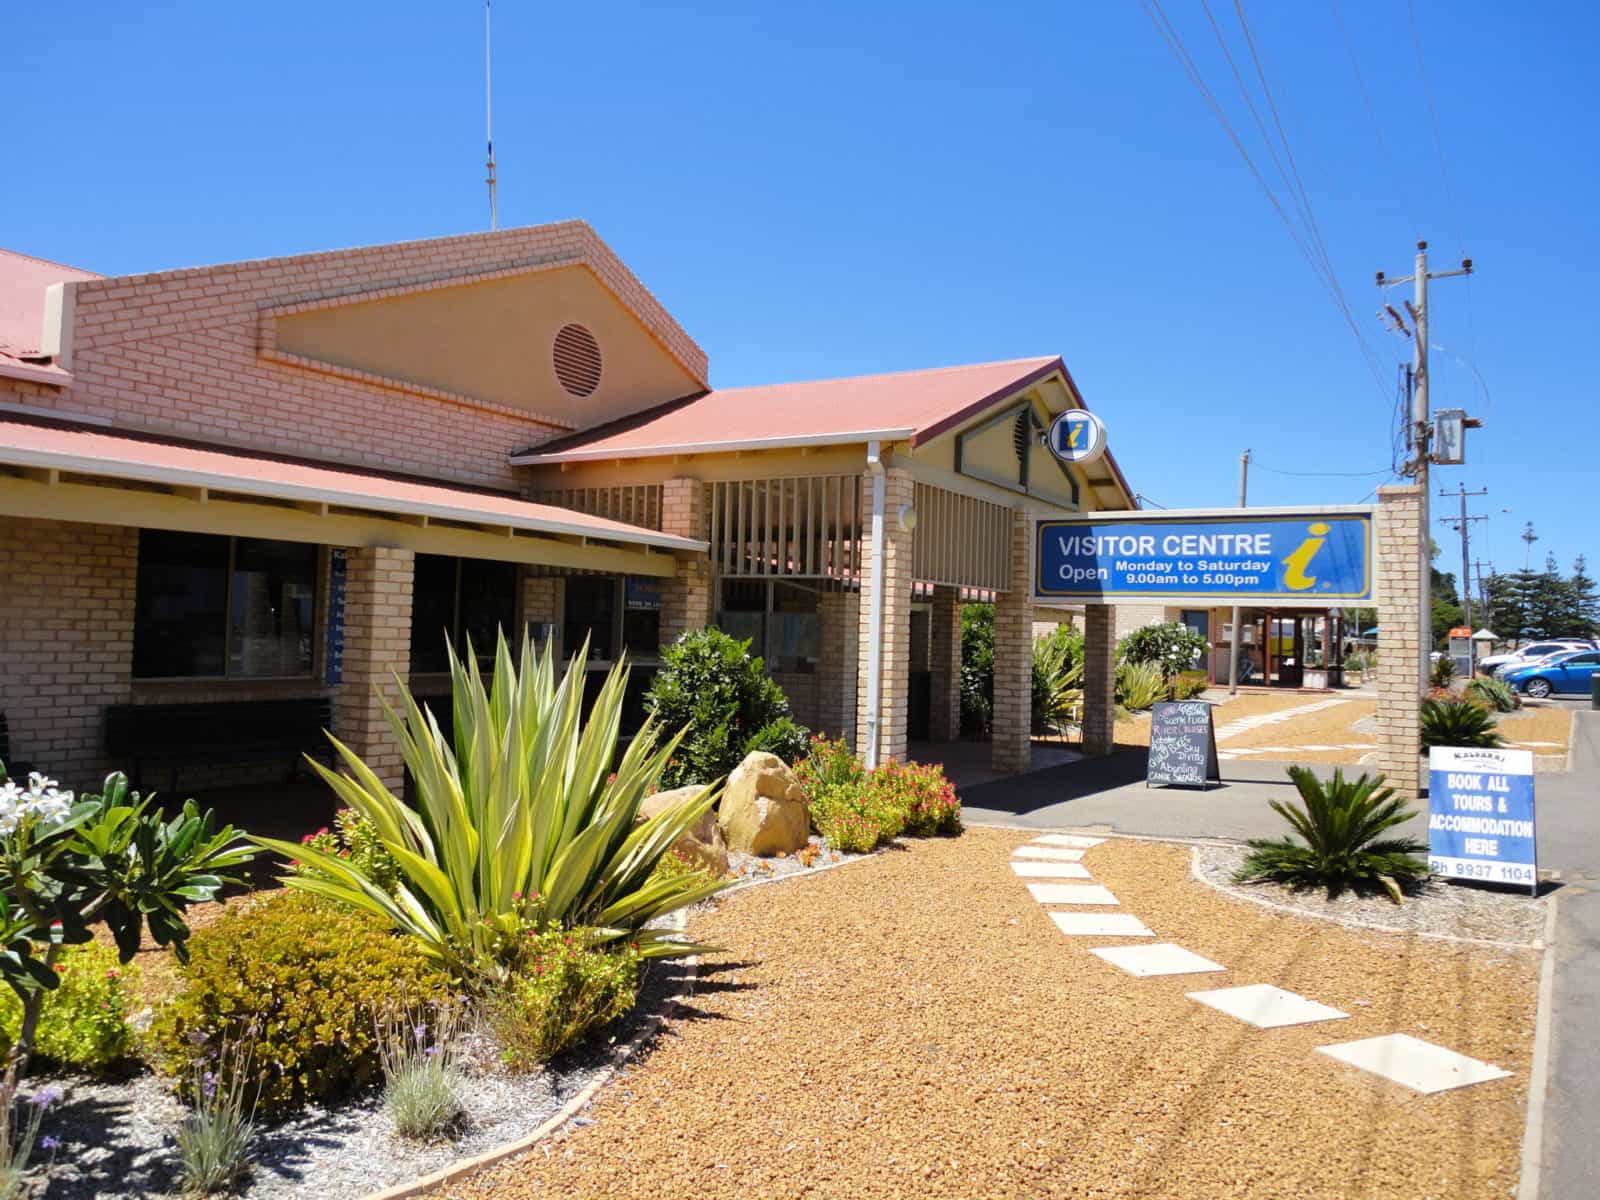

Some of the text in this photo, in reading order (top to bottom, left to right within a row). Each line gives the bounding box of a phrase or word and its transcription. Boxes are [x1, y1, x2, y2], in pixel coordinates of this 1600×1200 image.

[1059, 534, 1272, 557] VISITOR CENTRE
[1059, 564, 1108, 581] Open
[1115, 560, 1271, 574] Monday to Saturday
[1126, 573, 1259, 588] 9.00am to 5.00pm
[1448, 774, 1510, 792] BOOK ALL
[1452, 794, 1508, 813] TOURS &
[1429, 814, 1533, 838] ACCOMMODATION
[1464, 838, 1498, 856] HERE
[1455, 863, 1492, 878] 9937
[1501, 866, 1532, 880] 1104
